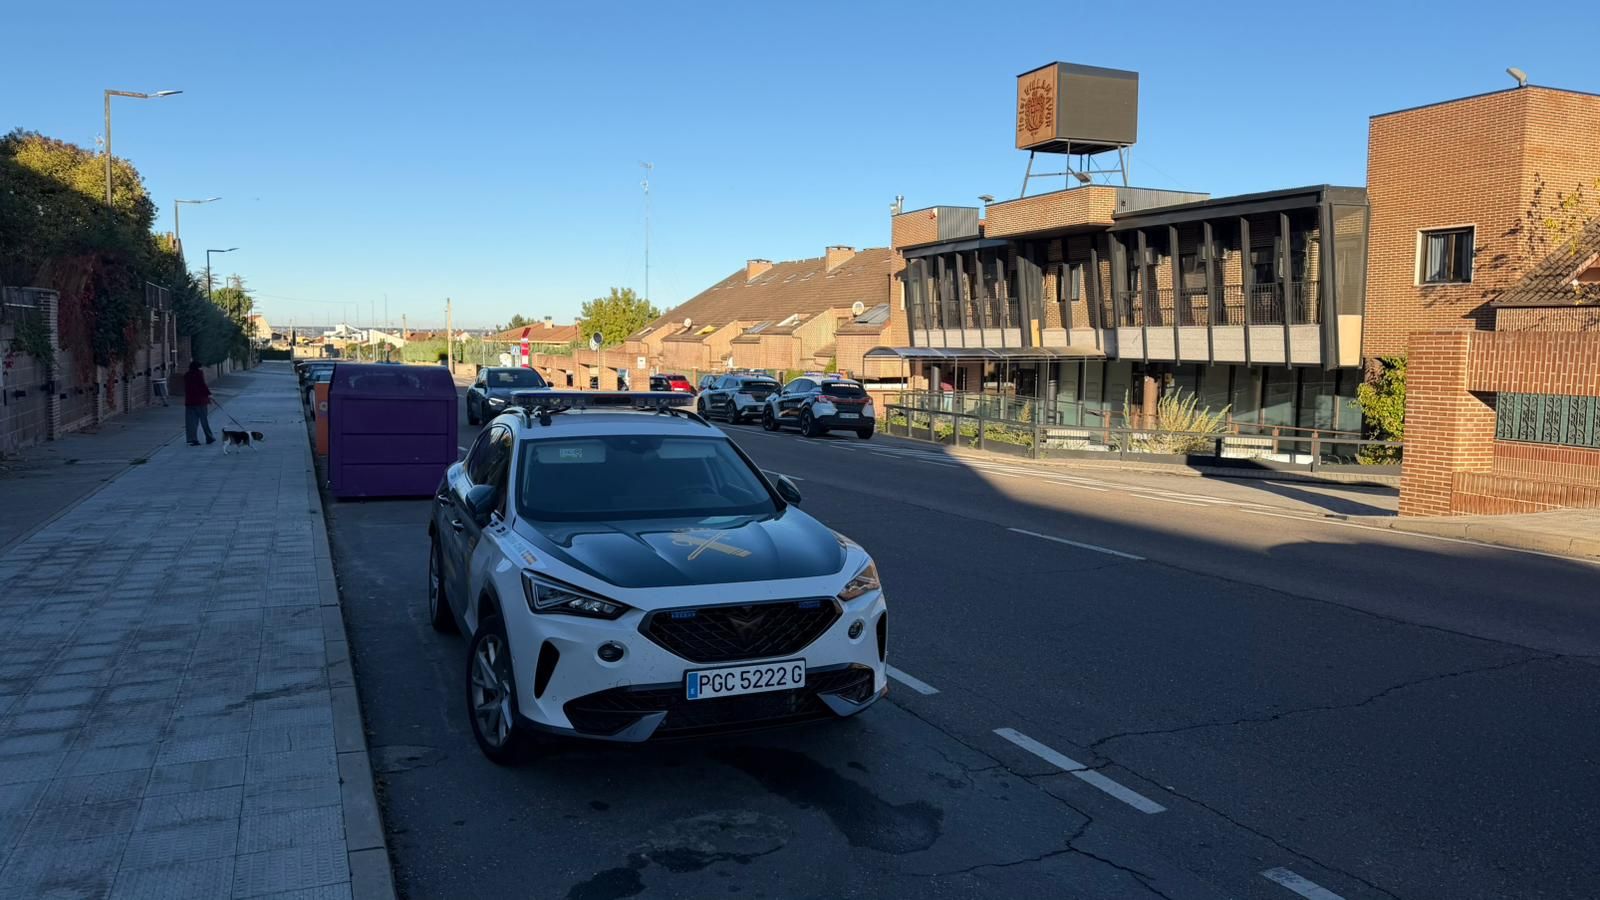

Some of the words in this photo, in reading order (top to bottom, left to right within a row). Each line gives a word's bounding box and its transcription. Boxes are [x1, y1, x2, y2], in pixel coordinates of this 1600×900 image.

[699, 672, 735, 694] PGC
[740, 667, 787, 689] 5222
[791, 665, 802, 683] G
